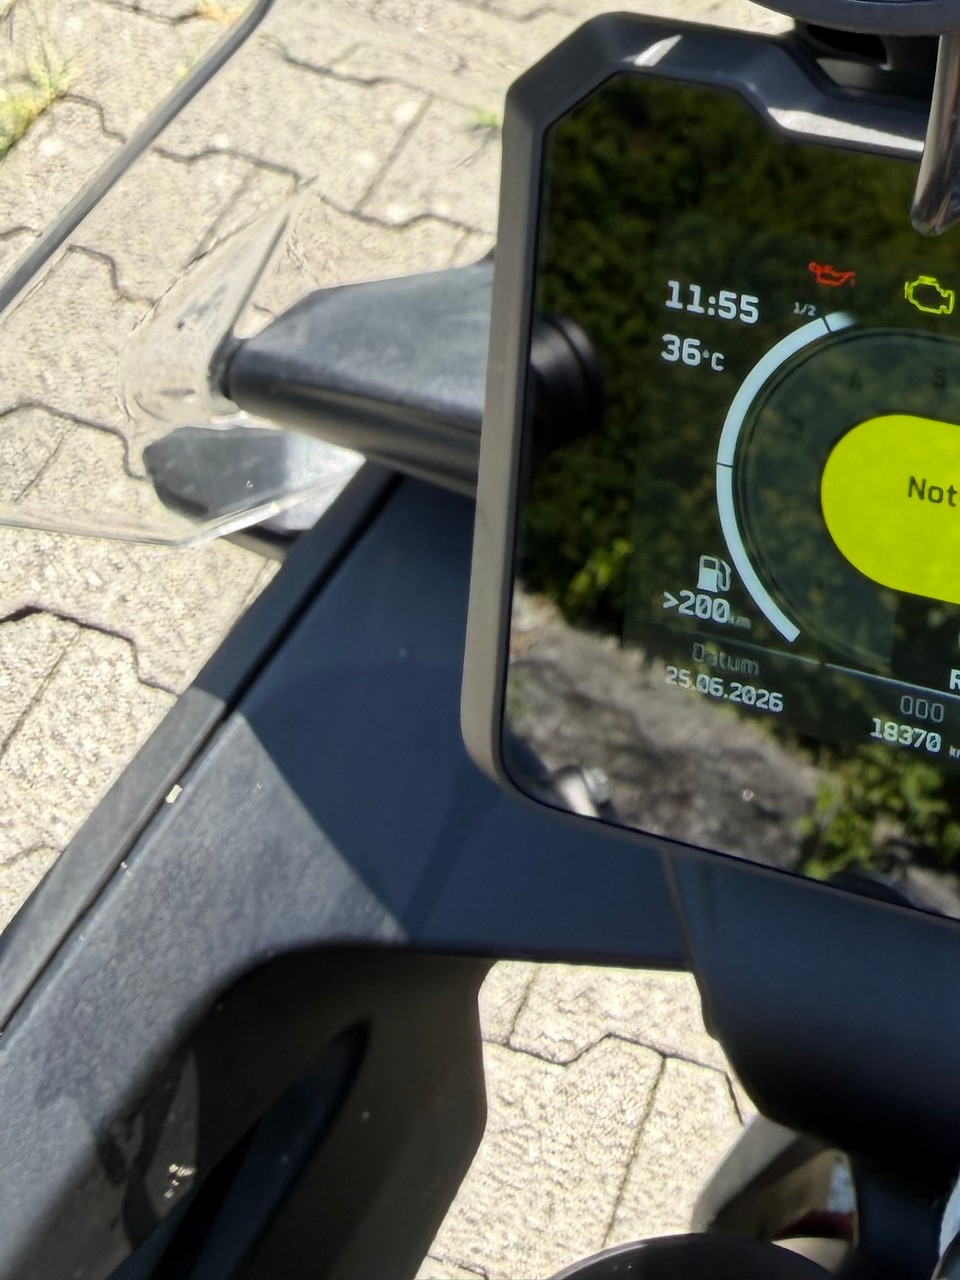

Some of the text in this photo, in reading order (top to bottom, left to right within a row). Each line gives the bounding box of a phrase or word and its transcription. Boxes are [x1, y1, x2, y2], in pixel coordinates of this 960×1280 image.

[665, 280, 759, 324] 11:55
[793, 301, 817, 317] 1/2
[665, 665, 784, 713] 25.06.2026
[870, 717, 942, 753] 18370
